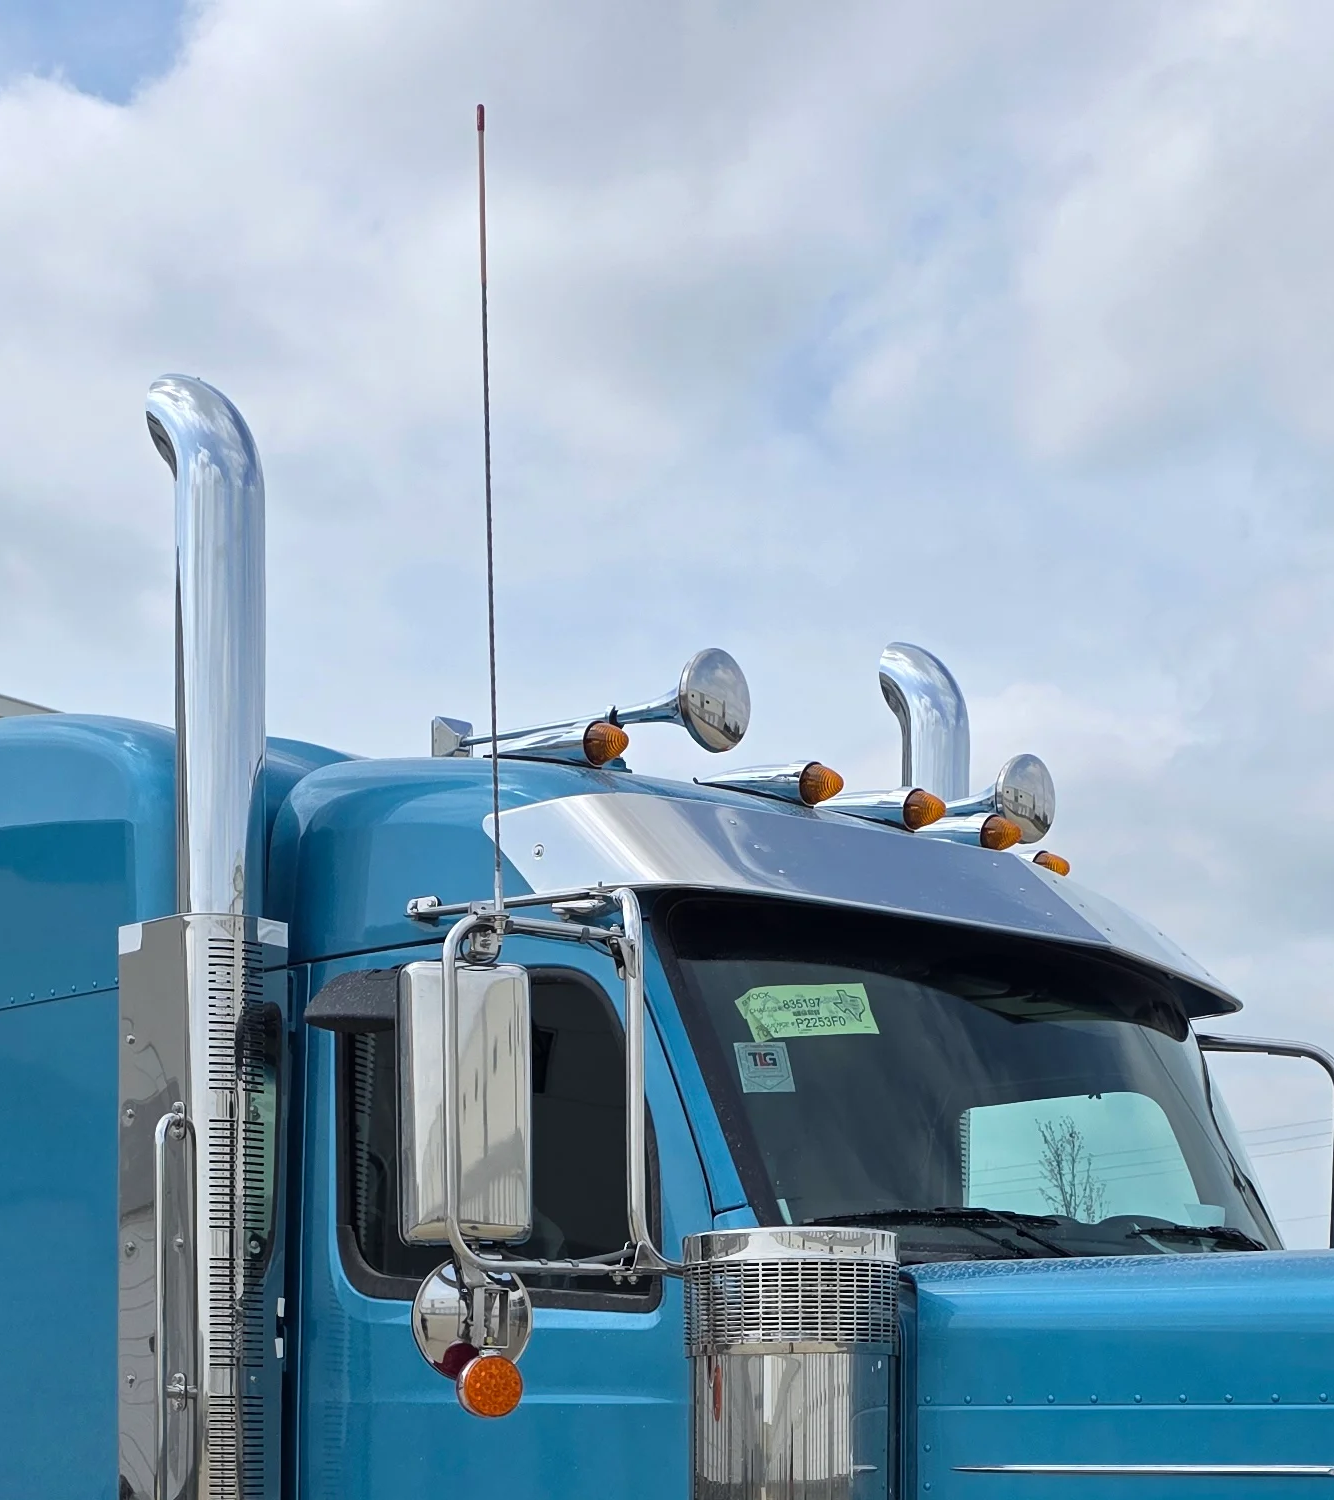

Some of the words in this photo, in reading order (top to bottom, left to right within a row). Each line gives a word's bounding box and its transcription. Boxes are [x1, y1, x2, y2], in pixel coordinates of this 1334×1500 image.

[783, 997, 821, 1010] 835197
[796, 1017, 846, 1029] P2253F0
[748, 1051, 778, 1067] TLG
